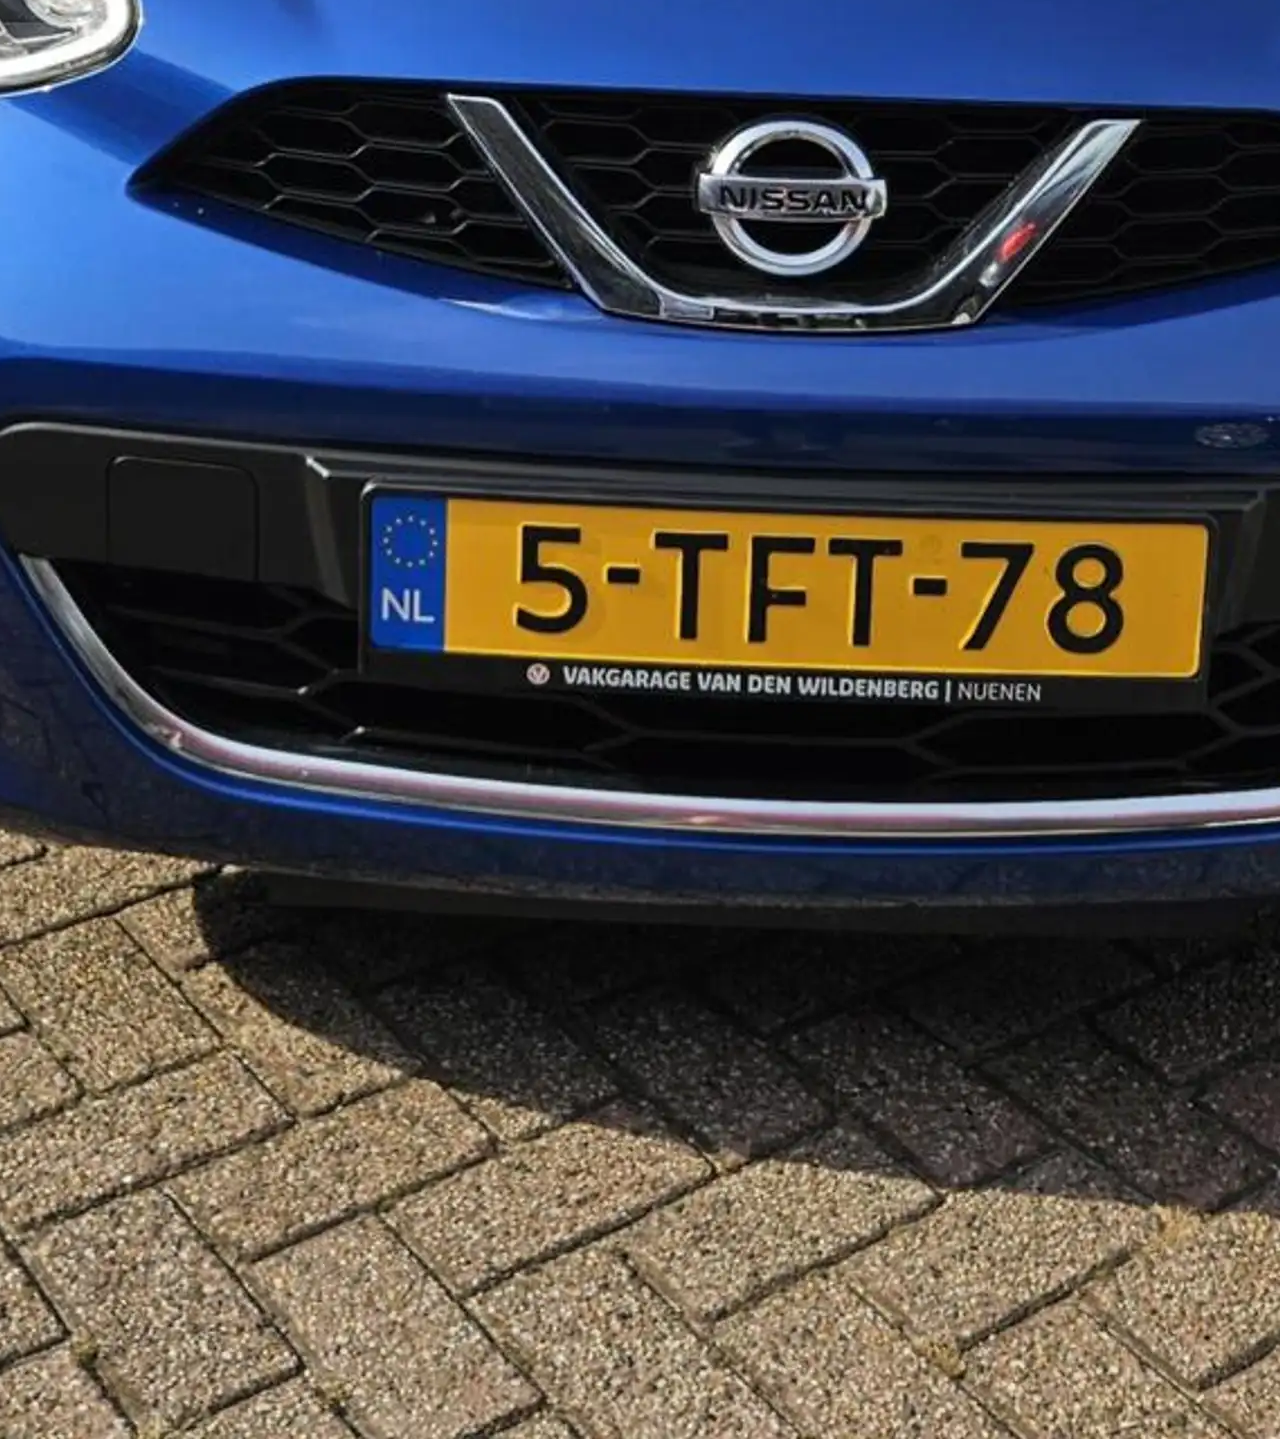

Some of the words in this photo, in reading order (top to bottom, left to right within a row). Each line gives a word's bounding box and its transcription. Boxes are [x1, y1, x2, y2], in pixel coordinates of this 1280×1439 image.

[719, 184, 869, 212] NISSAN
[381, 588, 435, 625] NL
[513, 523, 1126, 656] 5-TFT-78
[564, 664, 691, 693] VAKGARAGE
[697, 671, 742, 694] VAN
[748, 674, 792, 696] DEN
[798, 675, 940, 702] WILDENBERG
[957, 682, 1042, 703] NUENEN
